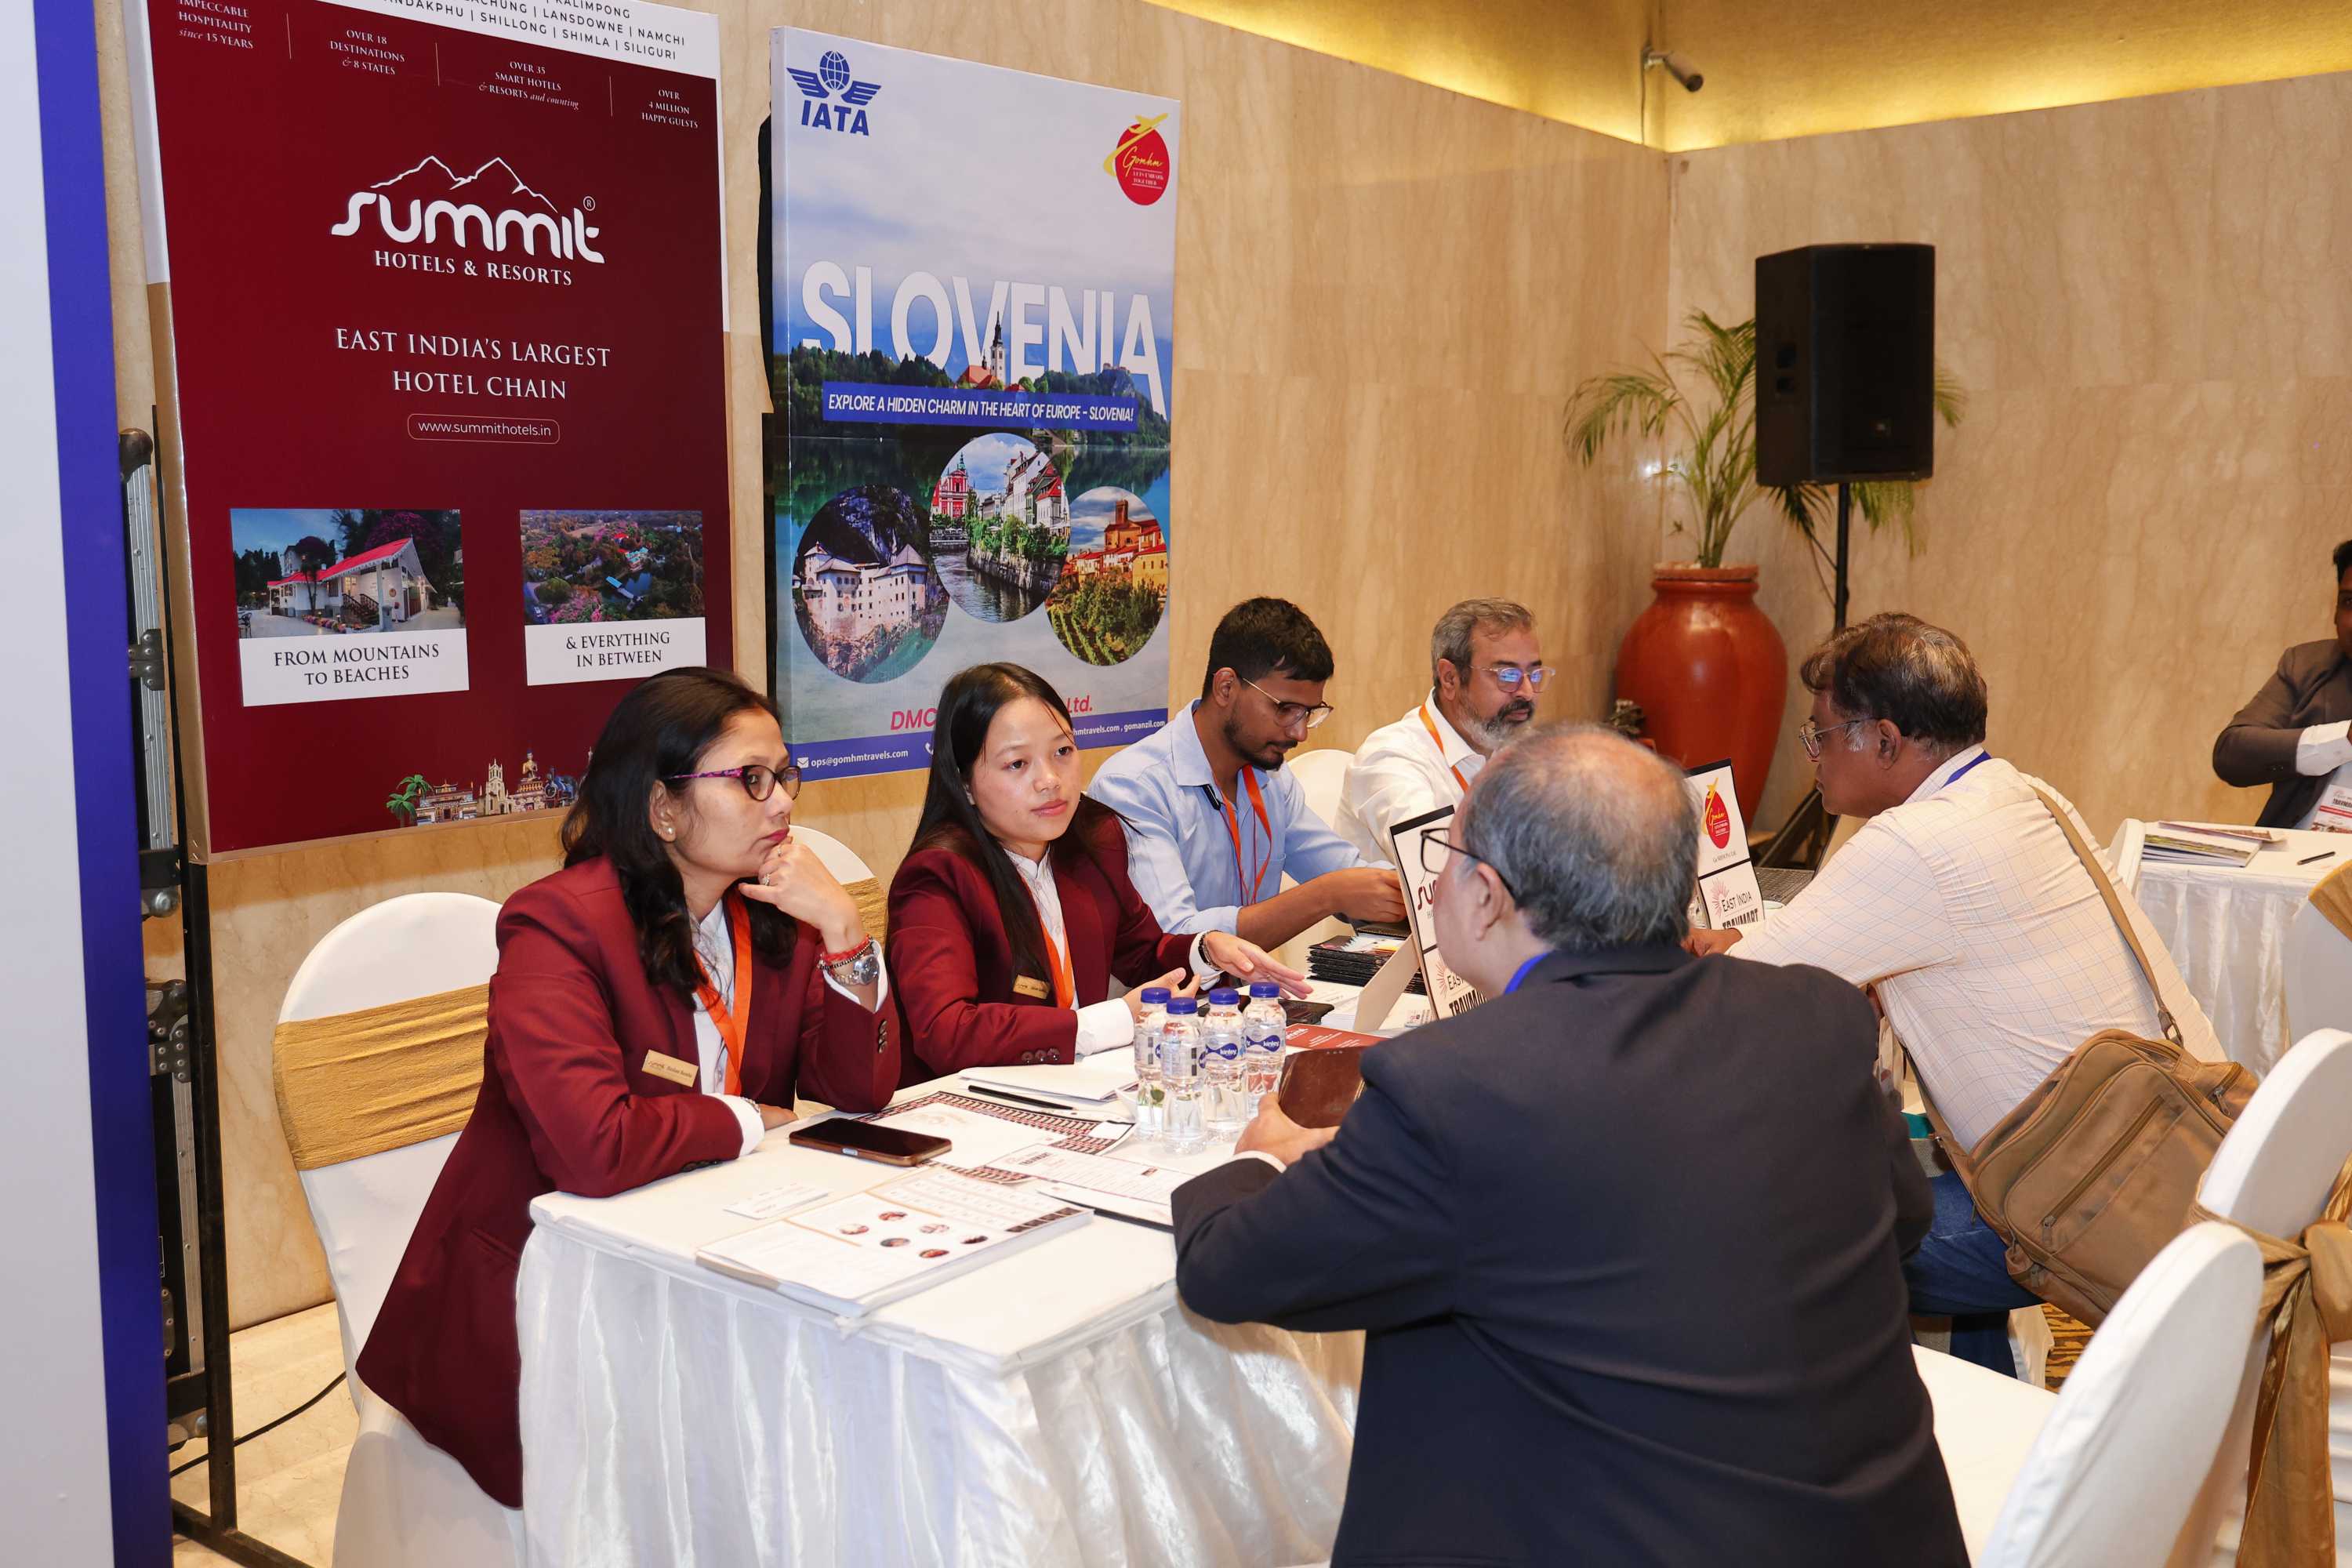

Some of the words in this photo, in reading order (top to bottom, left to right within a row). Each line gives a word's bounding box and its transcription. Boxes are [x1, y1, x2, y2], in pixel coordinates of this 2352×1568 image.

[179, 0, 249, 18] IMPECCABLE
[179, 11, 252, 34] HOSPITALITY
[543, 9, 624, 34] LANSDOWNE
[638, 29, 685, 46] NAMCHI
[179, 27, 203, 39] since
[206, 33, 218, 42] 15
[220, 35, 253, 49] YEARS
[347, 30, 374, 42] OVER
[377, 35, 387, 45] 18
[481, 13, 547, 34] SHILLONG
[562, 29, 610, 47] SHIMLA
[624, 42, 677, 60] SILIGURI
[330, 41, 405, 63] DESTINATIONS
[361, 62, 396, 75] STATES
[510, 61, 534, 73] OVER
[536, 66, 546, 74] 35
[495, 71, 524, 85] SMART
[528, 78, 561, 92] HOTELS
[489, 85, 528, 99] RESORTS
[530, 93, 545, 103] and
[546, 96, 579, 111] counting
[659, 89, 680, 100] OVER
[655, 103, 690, 114] MILLION
[800, 100, 869, 136] IATA
[641, 112, 667, 124] HAPPY
[669, 117, 699, 129] GUESTS
[375, 250, 456, 275] HOTELS
[463, 260, 479, 277] &
[487, 262, 573, 286] RESORTS
[336, 328, 397, 353] EAST
[408, 333, 502, 361] INDIA'S
[511, 342, 611, 368] LARGEST
[393, 370, 479, 395] HOTEL
[486, 376, 567, 400] CHAIN
[828, 394, 876, 412] EXPLORE
[877, 397, 885, 412] A
[887, 397, 926, 414] HIDDEN
[927, 398, 966, 416] CHARM
[967, 401, 979, 416] IN
[981, 401, 998, 417] THE
[1000, 401, 1031, 418] HEART
[1032, 403, 1047, 419] OF
[1046, 405, 1081, 420] EUROPE
[1089, 406, 1134, 422] SLOVENIA!
[418, 420, 552, 437] www.summithotels.in
[566, 636, 578, 650] &
[581, 631, 670, 649] EVERYTHING
[274, 649, 327, 666] FROM
[333, 644, 440, 663] MOUNTAINS
[577, 654, 593, 667] IN
[598, 650, 662, 666] BETWEEN
[304, 672, 328, 685] TO
[334, 665, 409, 684] BEACHES
[811, 750, 909, 768] ops@gomhmtravels.com
[1722, 897, 1736, 912] EAST
[1737, 891, 1752, 906] INDIA
[1447, 975, 1464, 990] EAS
